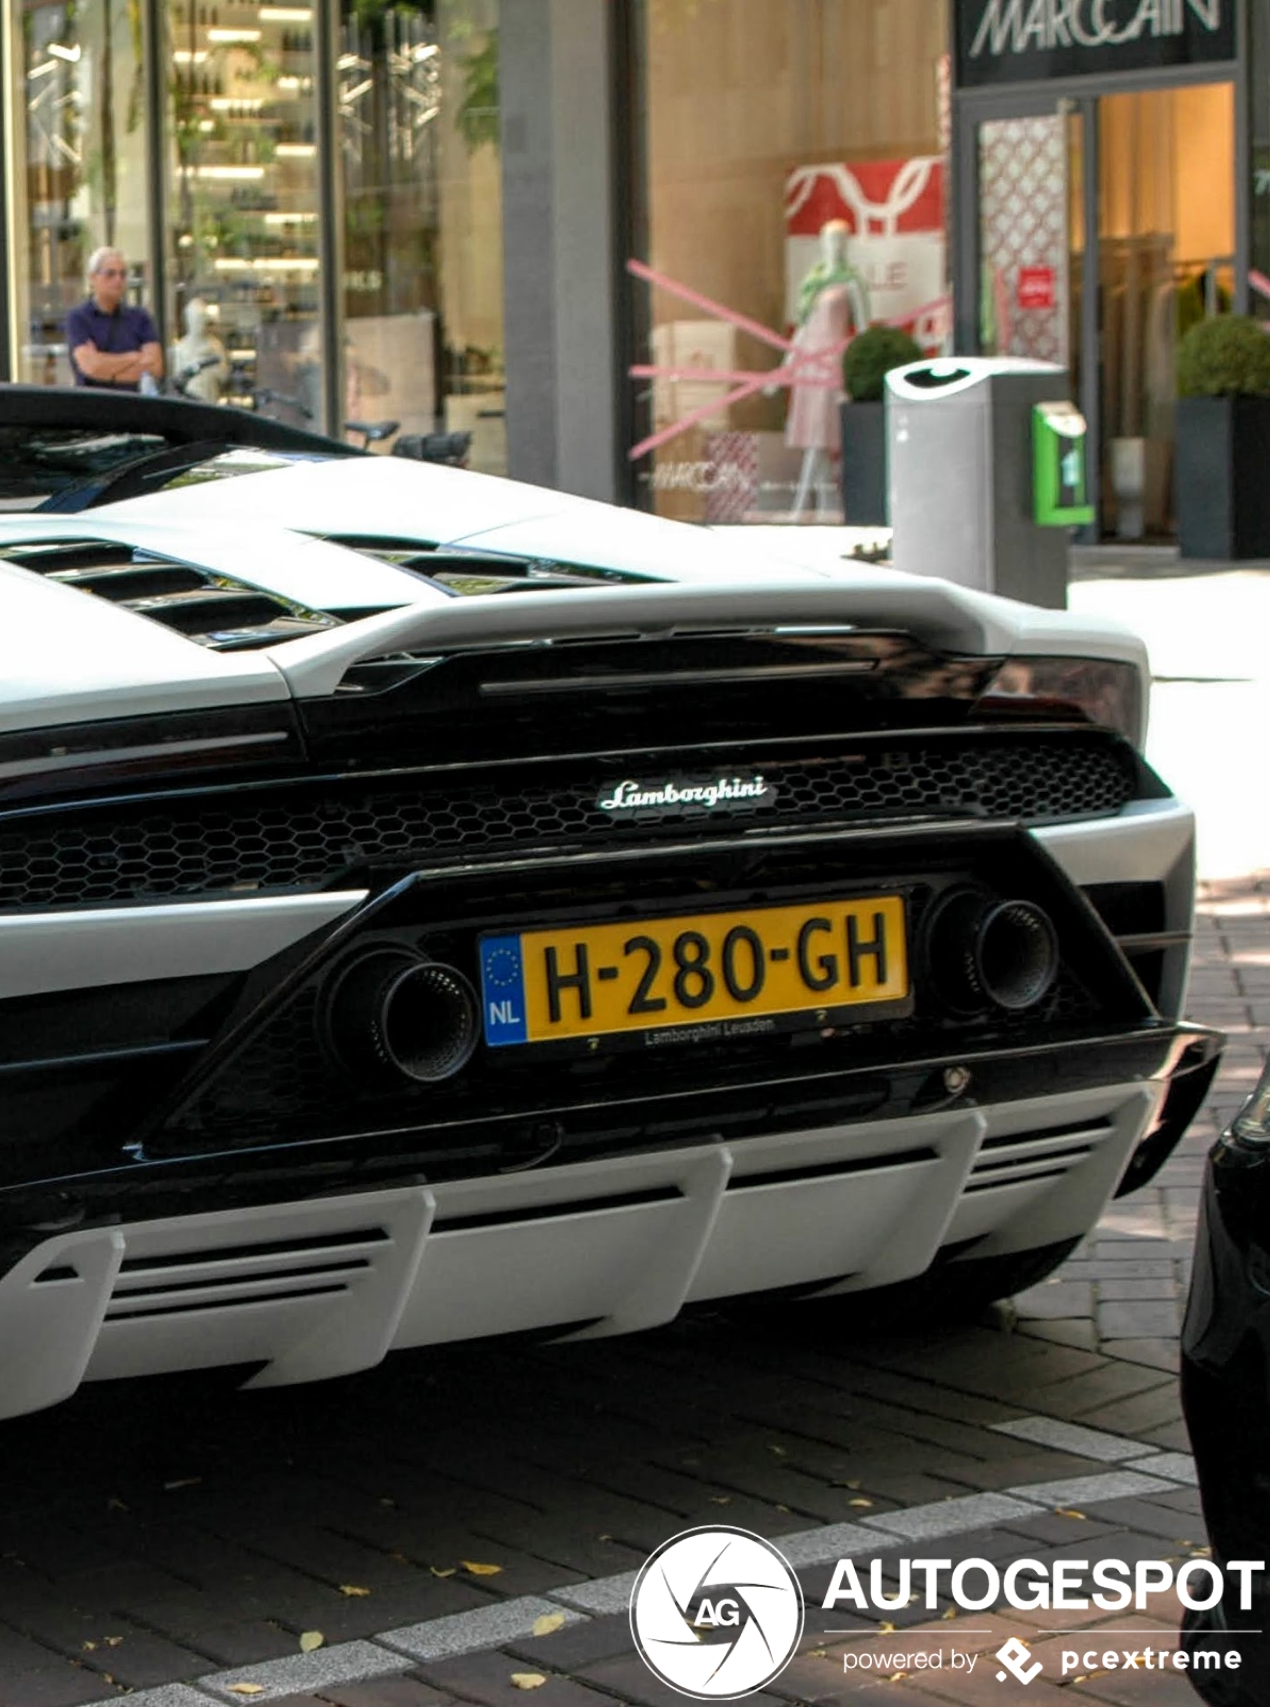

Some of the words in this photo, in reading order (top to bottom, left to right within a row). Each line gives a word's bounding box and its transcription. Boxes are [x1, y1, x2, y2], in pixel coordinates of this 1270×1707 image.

[600, 776, 768, 810] Lamborghini
[543, 911, 888, 1024] H-280-GH
[489, 1001, 520, 1026] NL
[644, 1023, 721, 1046] Lamborghini
